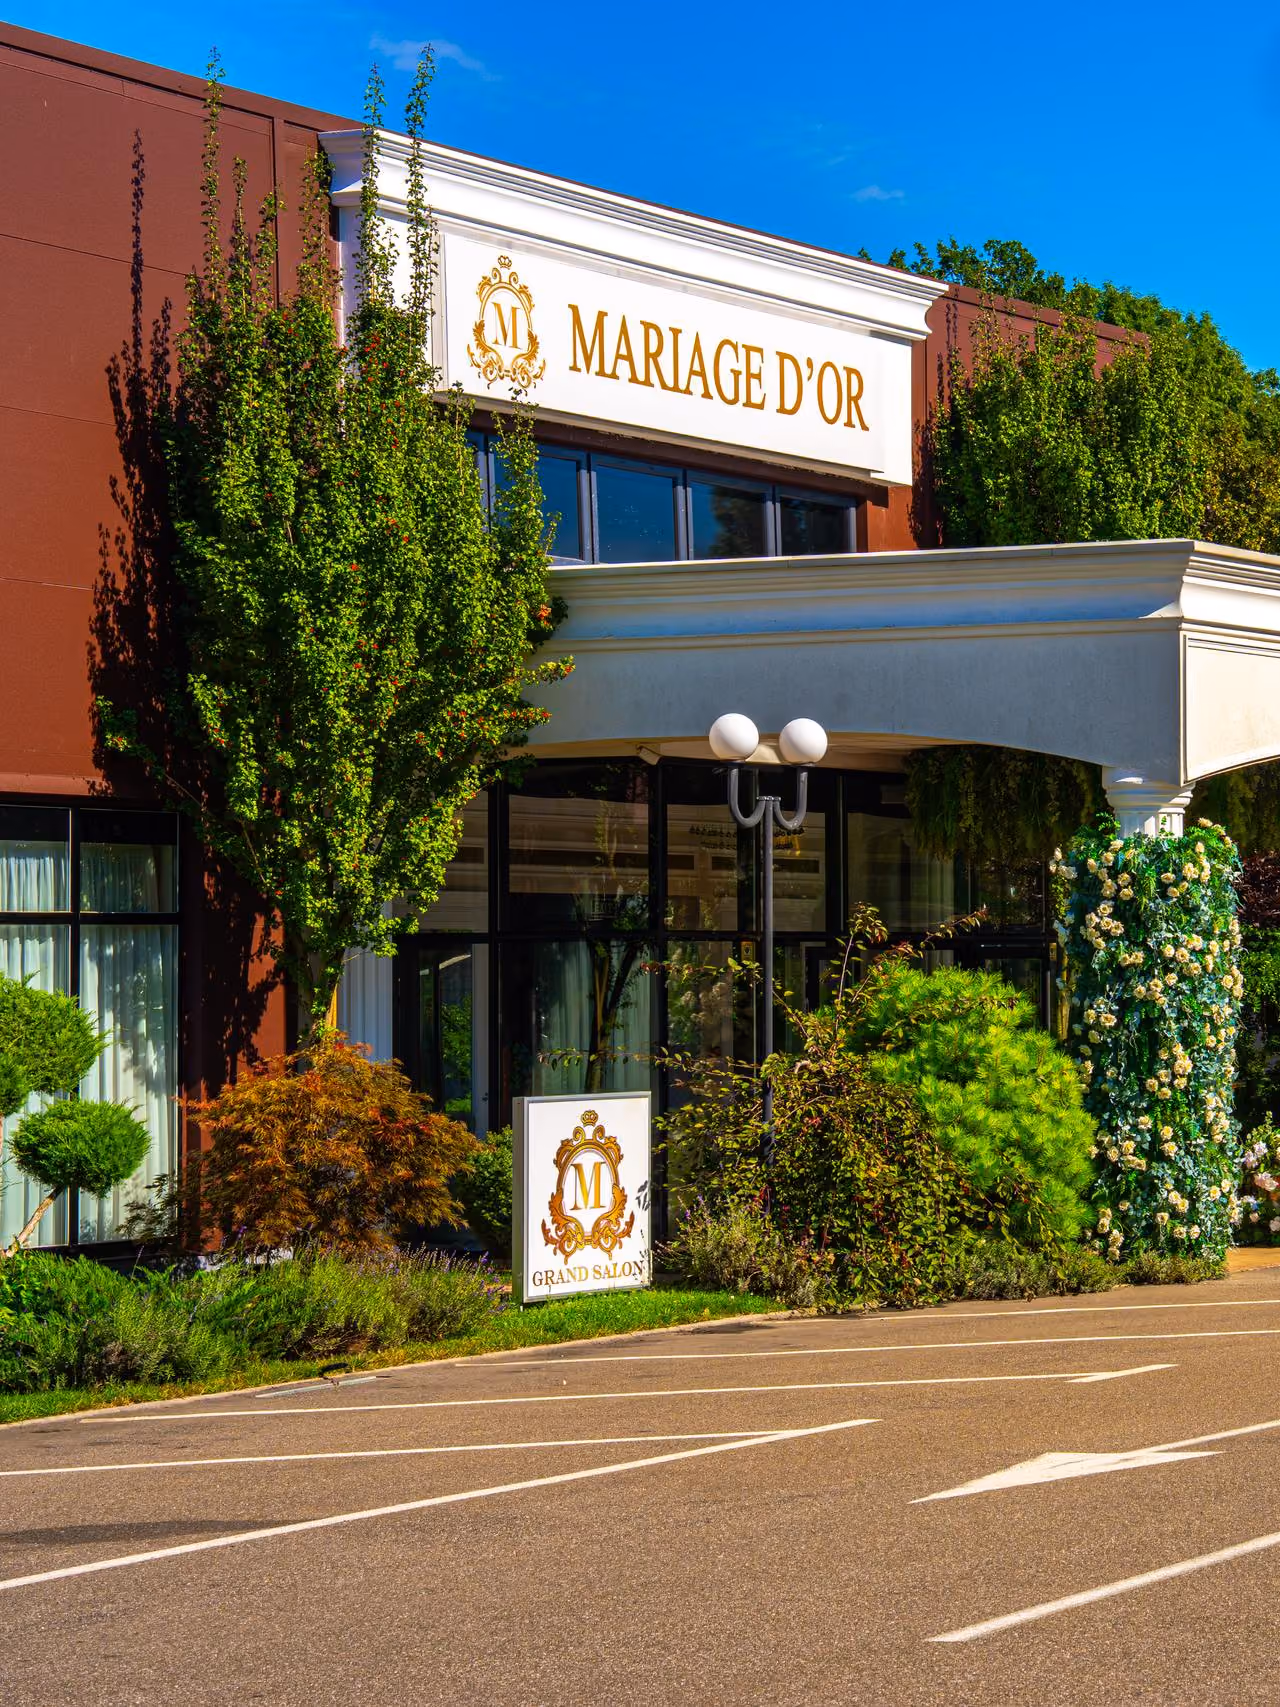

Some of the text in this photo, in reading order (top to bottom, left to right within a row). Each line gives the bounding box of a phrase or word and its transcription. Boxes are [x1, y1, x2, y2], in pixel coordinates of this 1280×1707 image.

[493, 303, 522, 349] M
[569, 304, 766, 410] MARIAGE
[570, 1162, 606, 1210] M
[533, 1261, 643, 1286] GRAND SALON
